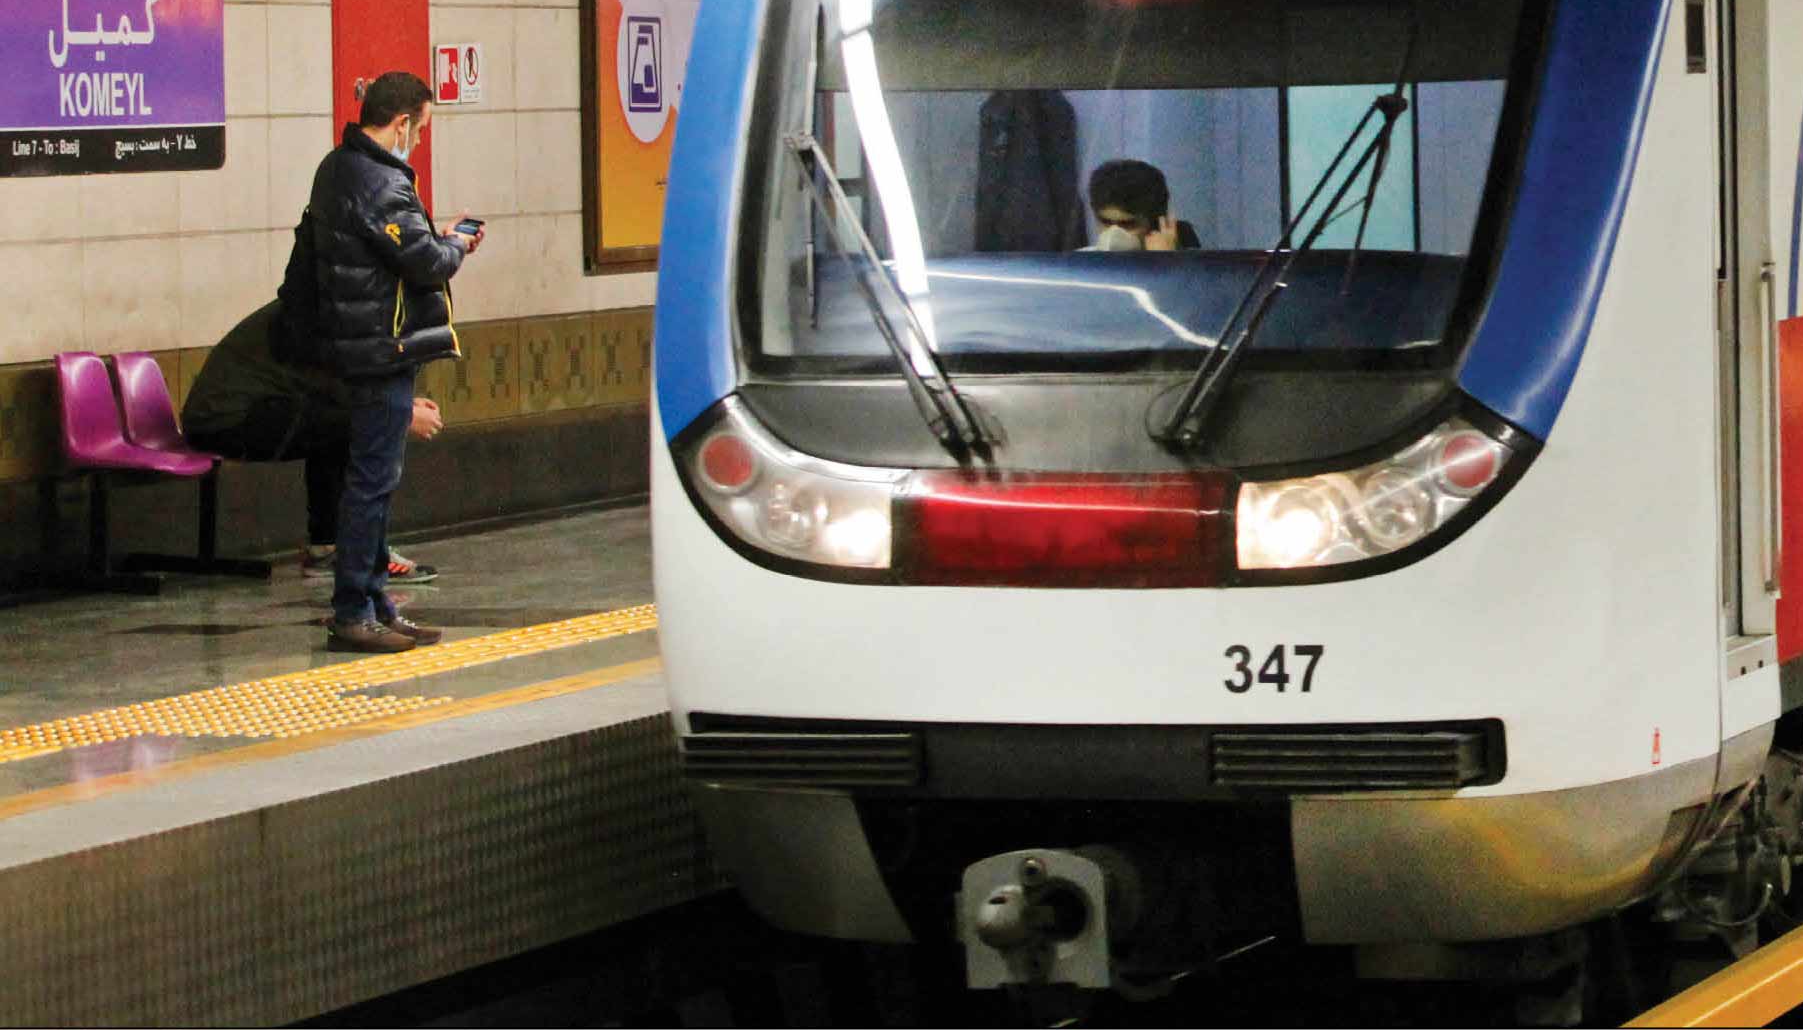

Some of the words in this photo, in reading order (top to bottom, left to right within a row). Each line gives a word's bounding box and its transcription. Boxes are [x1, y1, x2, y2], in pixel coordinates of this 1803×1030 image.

[60, 72, 152, 117] KOMEYL
[12, 140, 31, 156] Line
[32, 139, 37, 155] 7
[60, 139, 80, 158] Basij
[115, 141, 135, 160] بسیج
[184, 134, 197, 149] خط
[1224, 644, 1325, 694] 347
